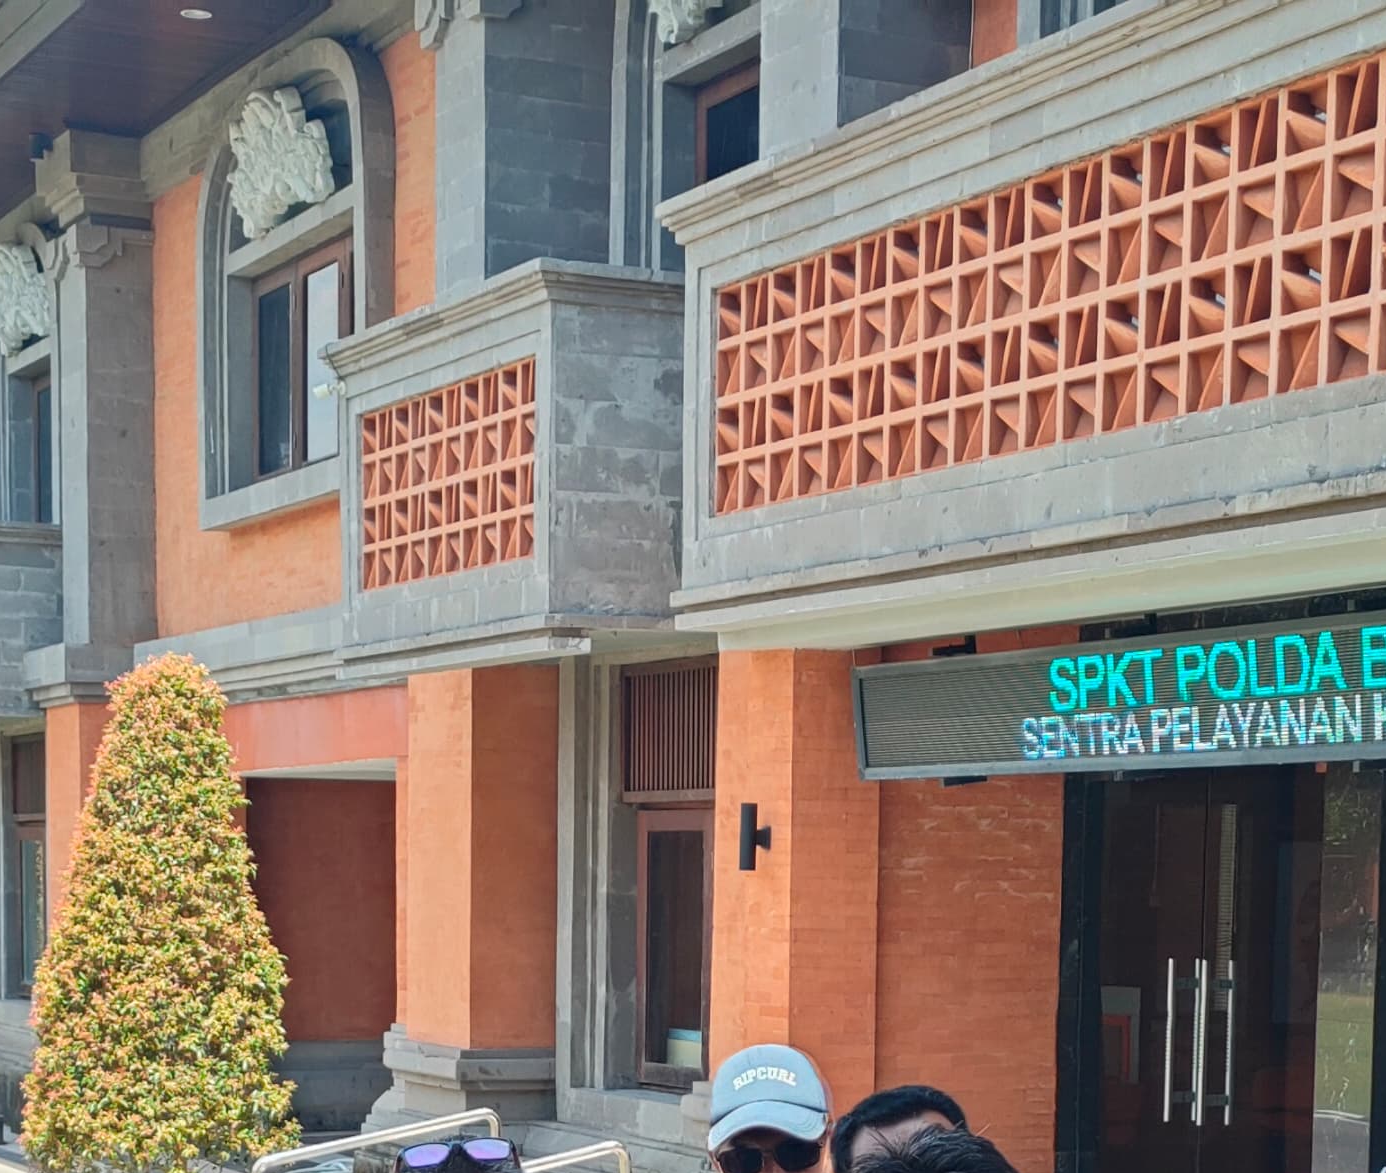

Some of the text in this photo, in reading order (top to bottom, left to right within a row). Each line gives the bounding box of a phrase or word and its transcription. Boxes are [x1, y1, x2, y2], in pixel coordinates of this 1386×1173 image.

[1049, 648, 1163, 713] SPKT
[1175, 630, 1348, 702] POLDA
[1021, 711, 1146, 760] SENTRA
[1150, 694, 1362, 753] PELAYANAN
